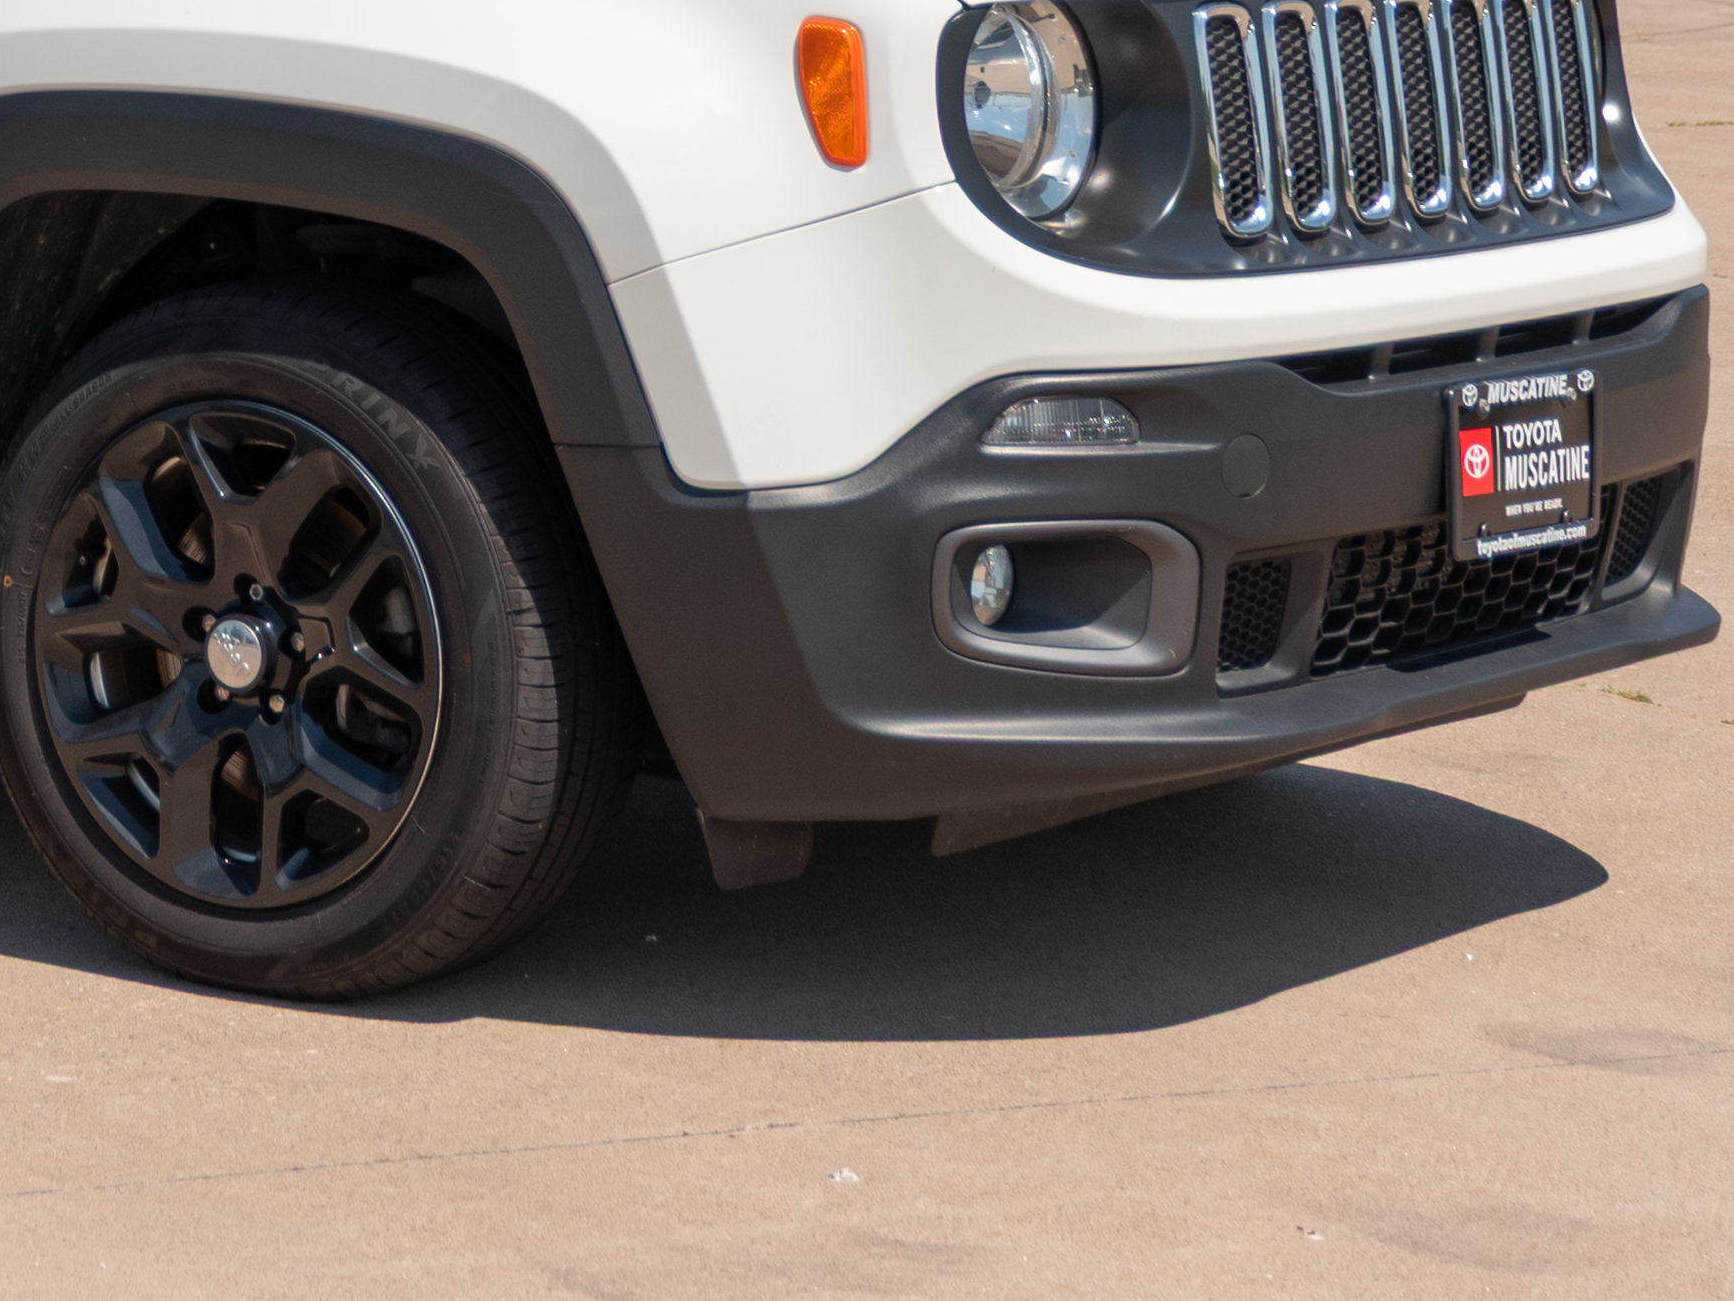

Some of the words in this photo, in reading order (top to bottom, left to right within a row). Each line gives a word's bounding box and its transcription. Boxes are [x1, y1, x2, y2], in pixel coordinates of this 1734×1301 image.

[1485, 375, 1568, 405] MUSCATINE
[1503, 419, 1563, 449] TOYOTA
[1505, 445, 1590, 491] MUSCATINE
[1477, 525, 1586, 558] toyotaofmuscatine.com
